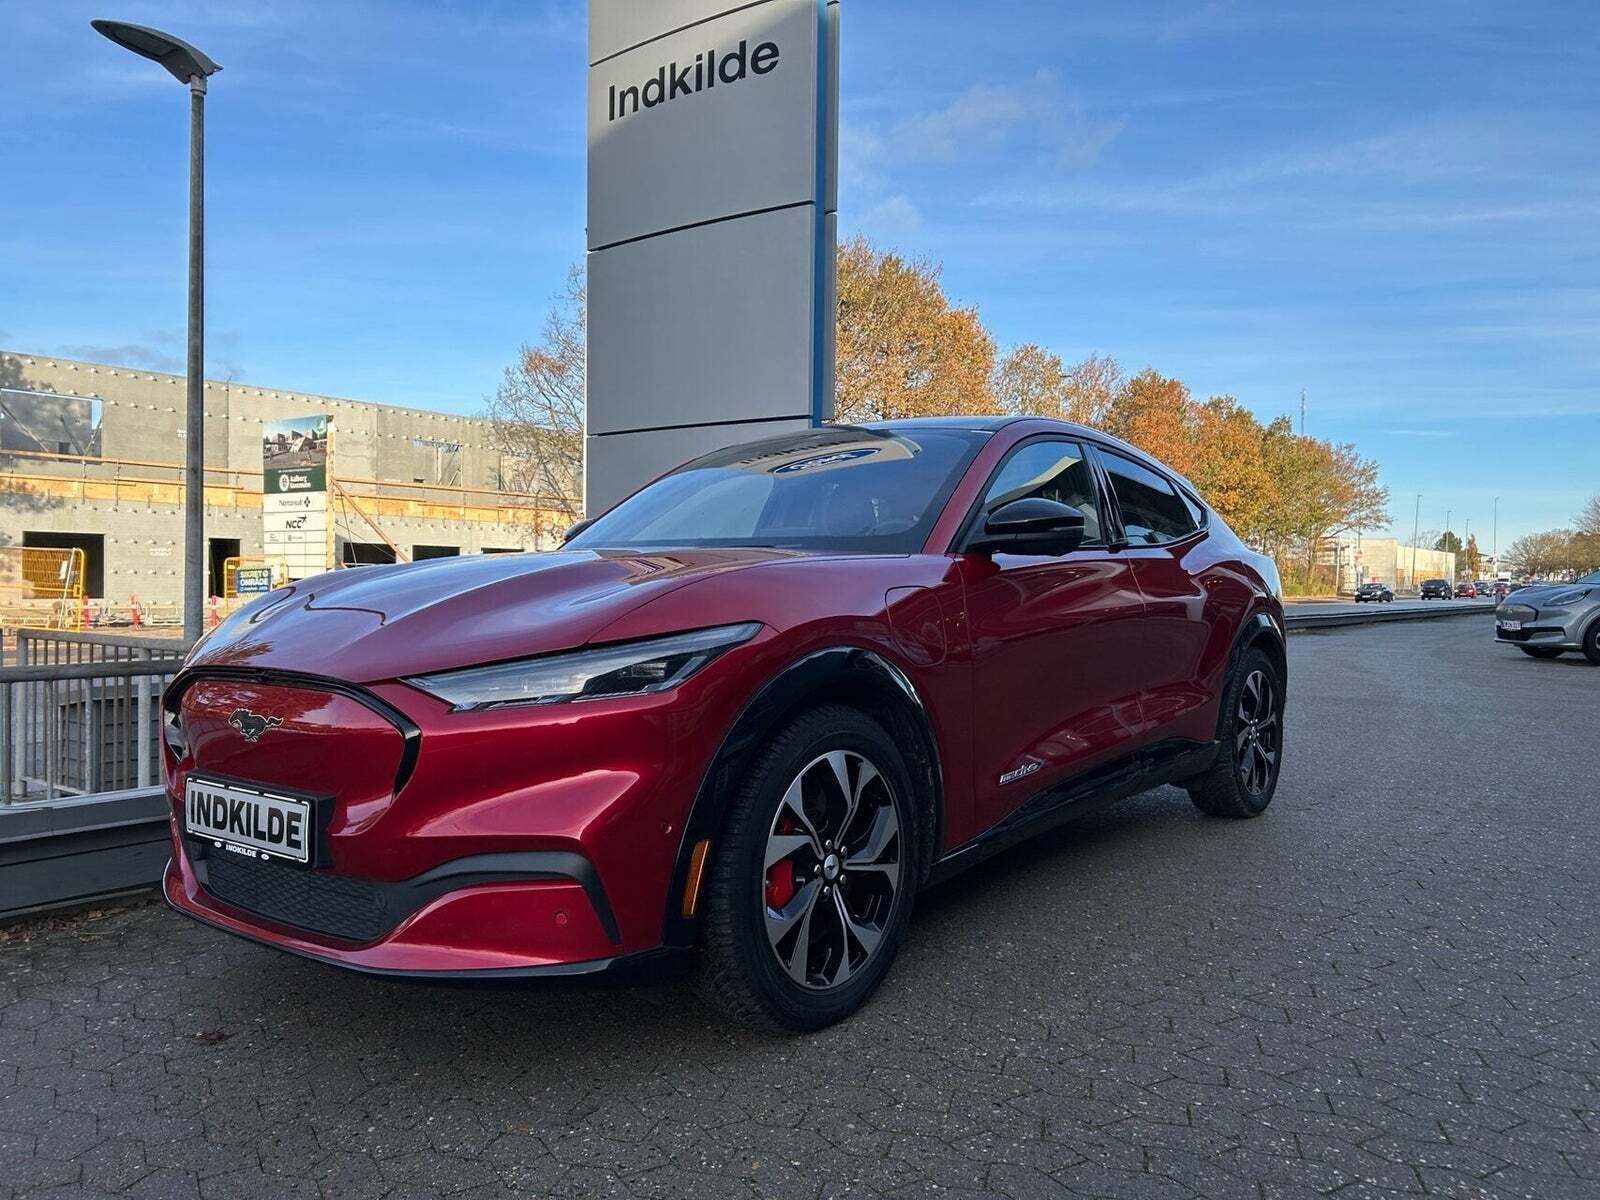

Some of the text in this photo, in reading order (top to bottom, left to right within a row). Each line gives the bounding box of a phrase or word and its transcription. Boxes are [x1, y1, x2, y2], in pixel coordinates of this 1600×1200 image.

[608, 39, 780, 121] Indkilde
[285, 519, 303, 529] NCC
[190, 790, 302, 849] INDKILDE
[225, 843, 257, 858] INDKILDE
